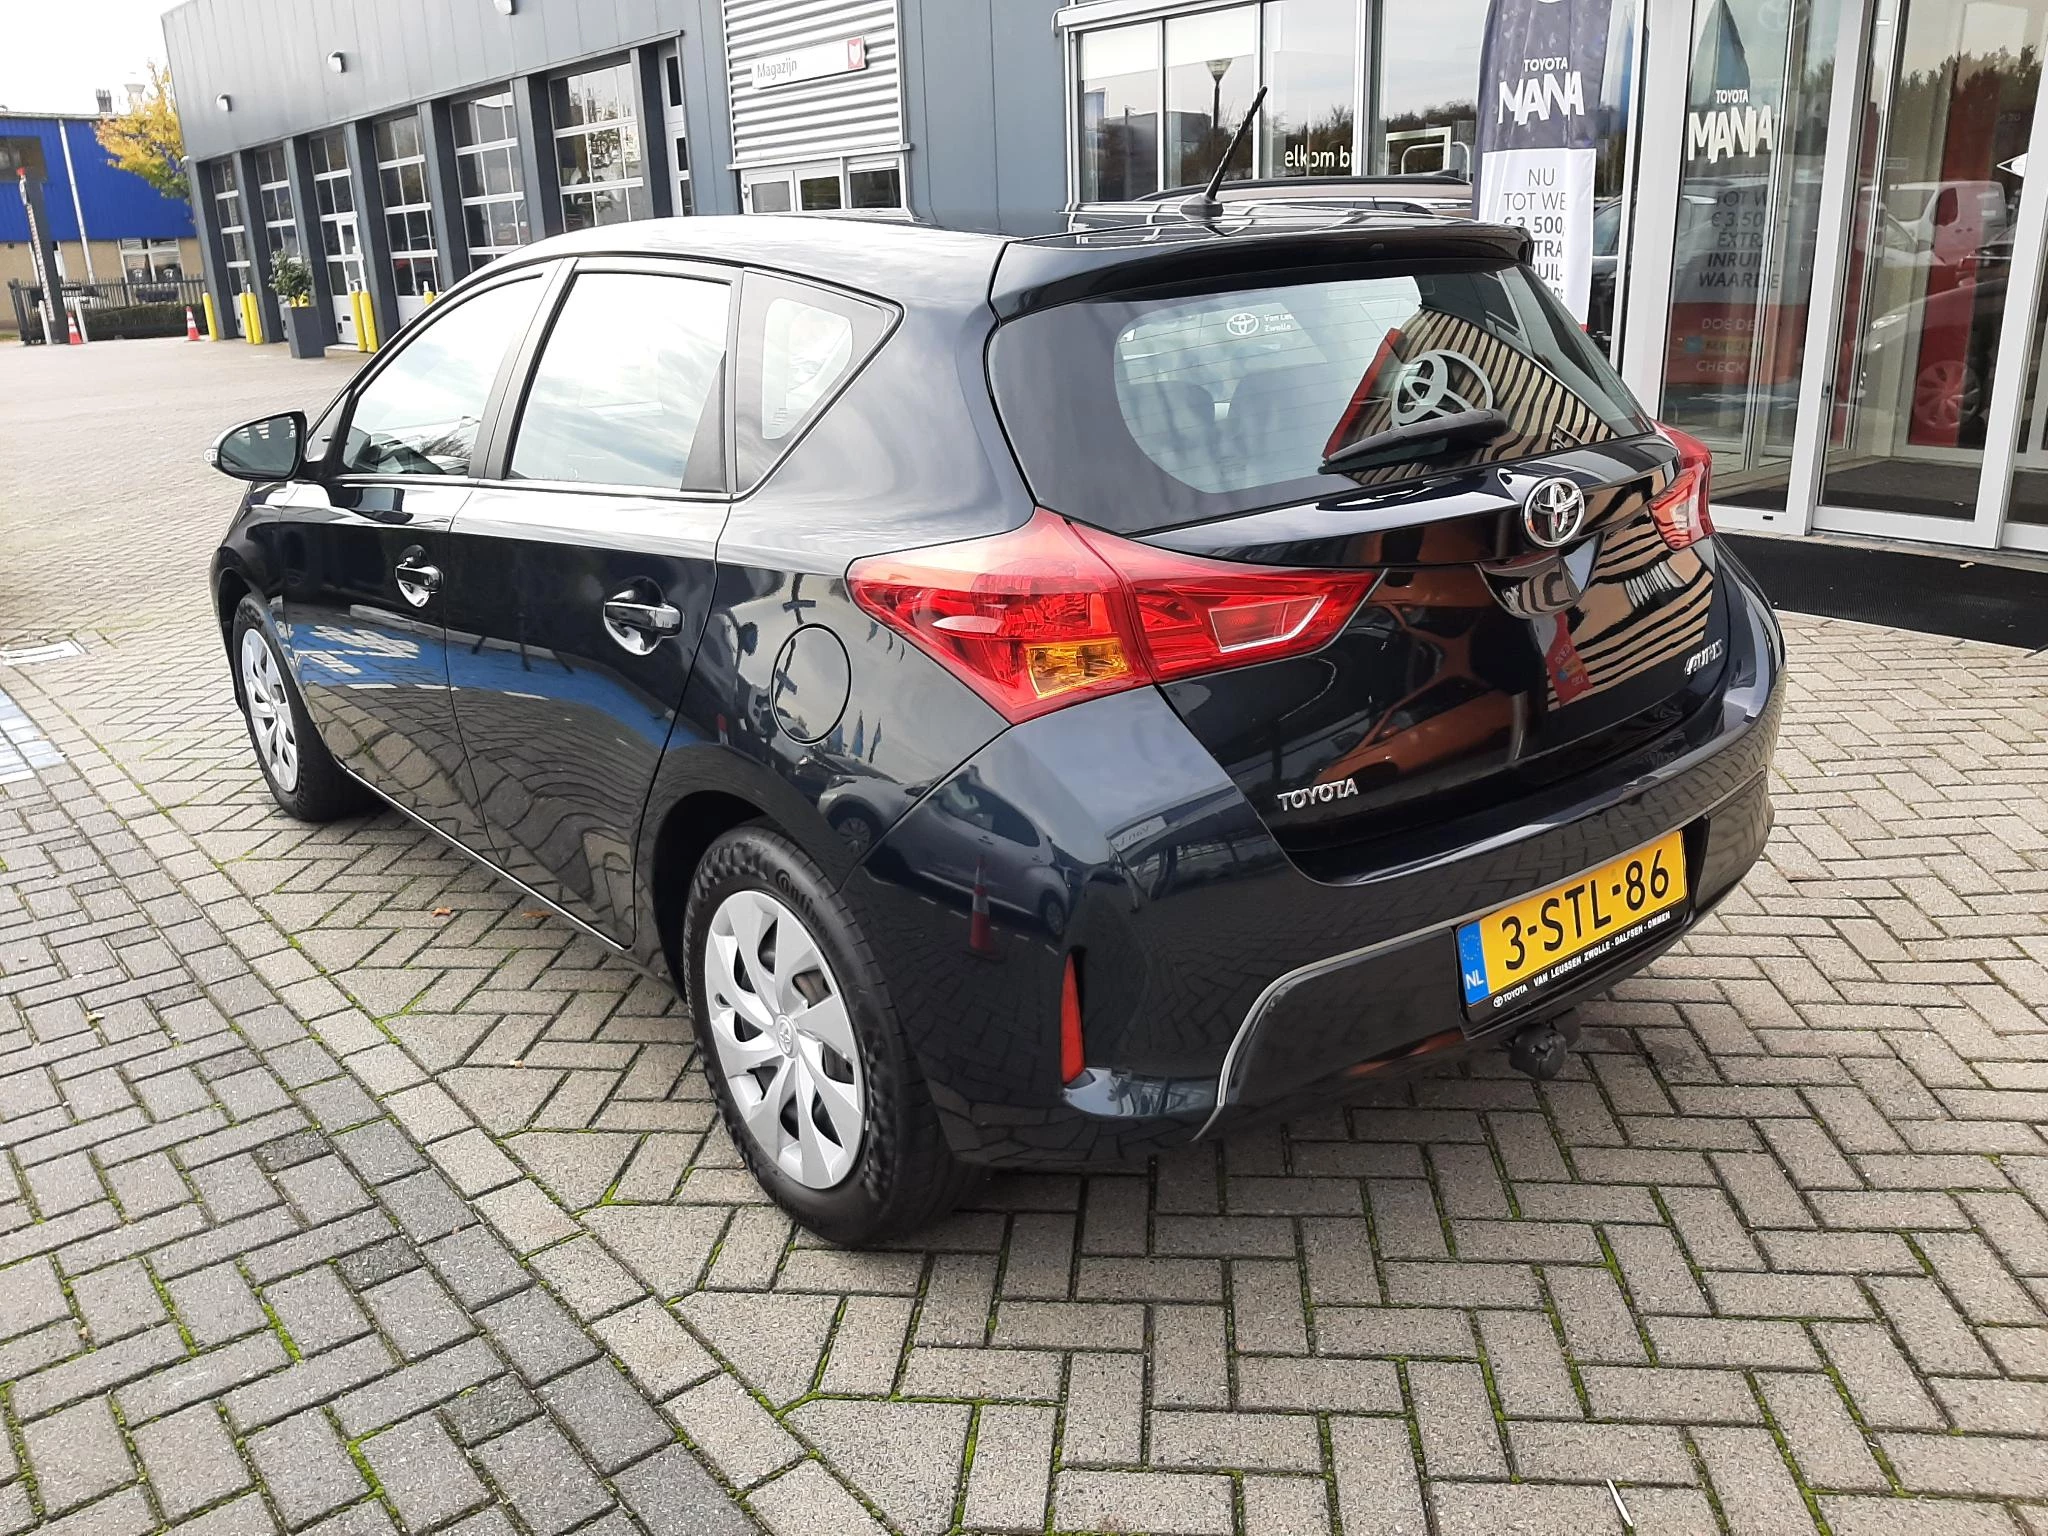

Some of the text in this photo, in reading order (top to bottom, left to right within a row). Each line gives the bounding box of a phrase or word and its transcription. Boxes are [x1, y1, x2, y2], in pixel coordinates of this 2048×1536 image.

[757, 58, 797, 80] Magazijn
[1523, 57, 1568, 72] TOYOTA
[1716, 89, 1749, 104] TOYOTA
[1688, 105, 1773, 164] MANIA
[1528, 167, 1555, 187] NU
[1504, 193, 1536, 211] TOT
[1696, 360, 1745, 373] CHECK
[1277, 778, 1359, 811] TOYOTA
[1501, 849, 1669, 970] 3-STL-86
[1503, 983, 1528, 1002] TOYOTA
[1533, 972, 1548, 987] VAN
[1550, 955, 1582, 979] LEUSSEN
[1583, 941, 1611, 962] ZWOLLE
[1614, 924, 1643, 946] DALFSEN
[1647, 910, 1671, 929] OMMEN
[1465, 969, 1484, 990] NL
